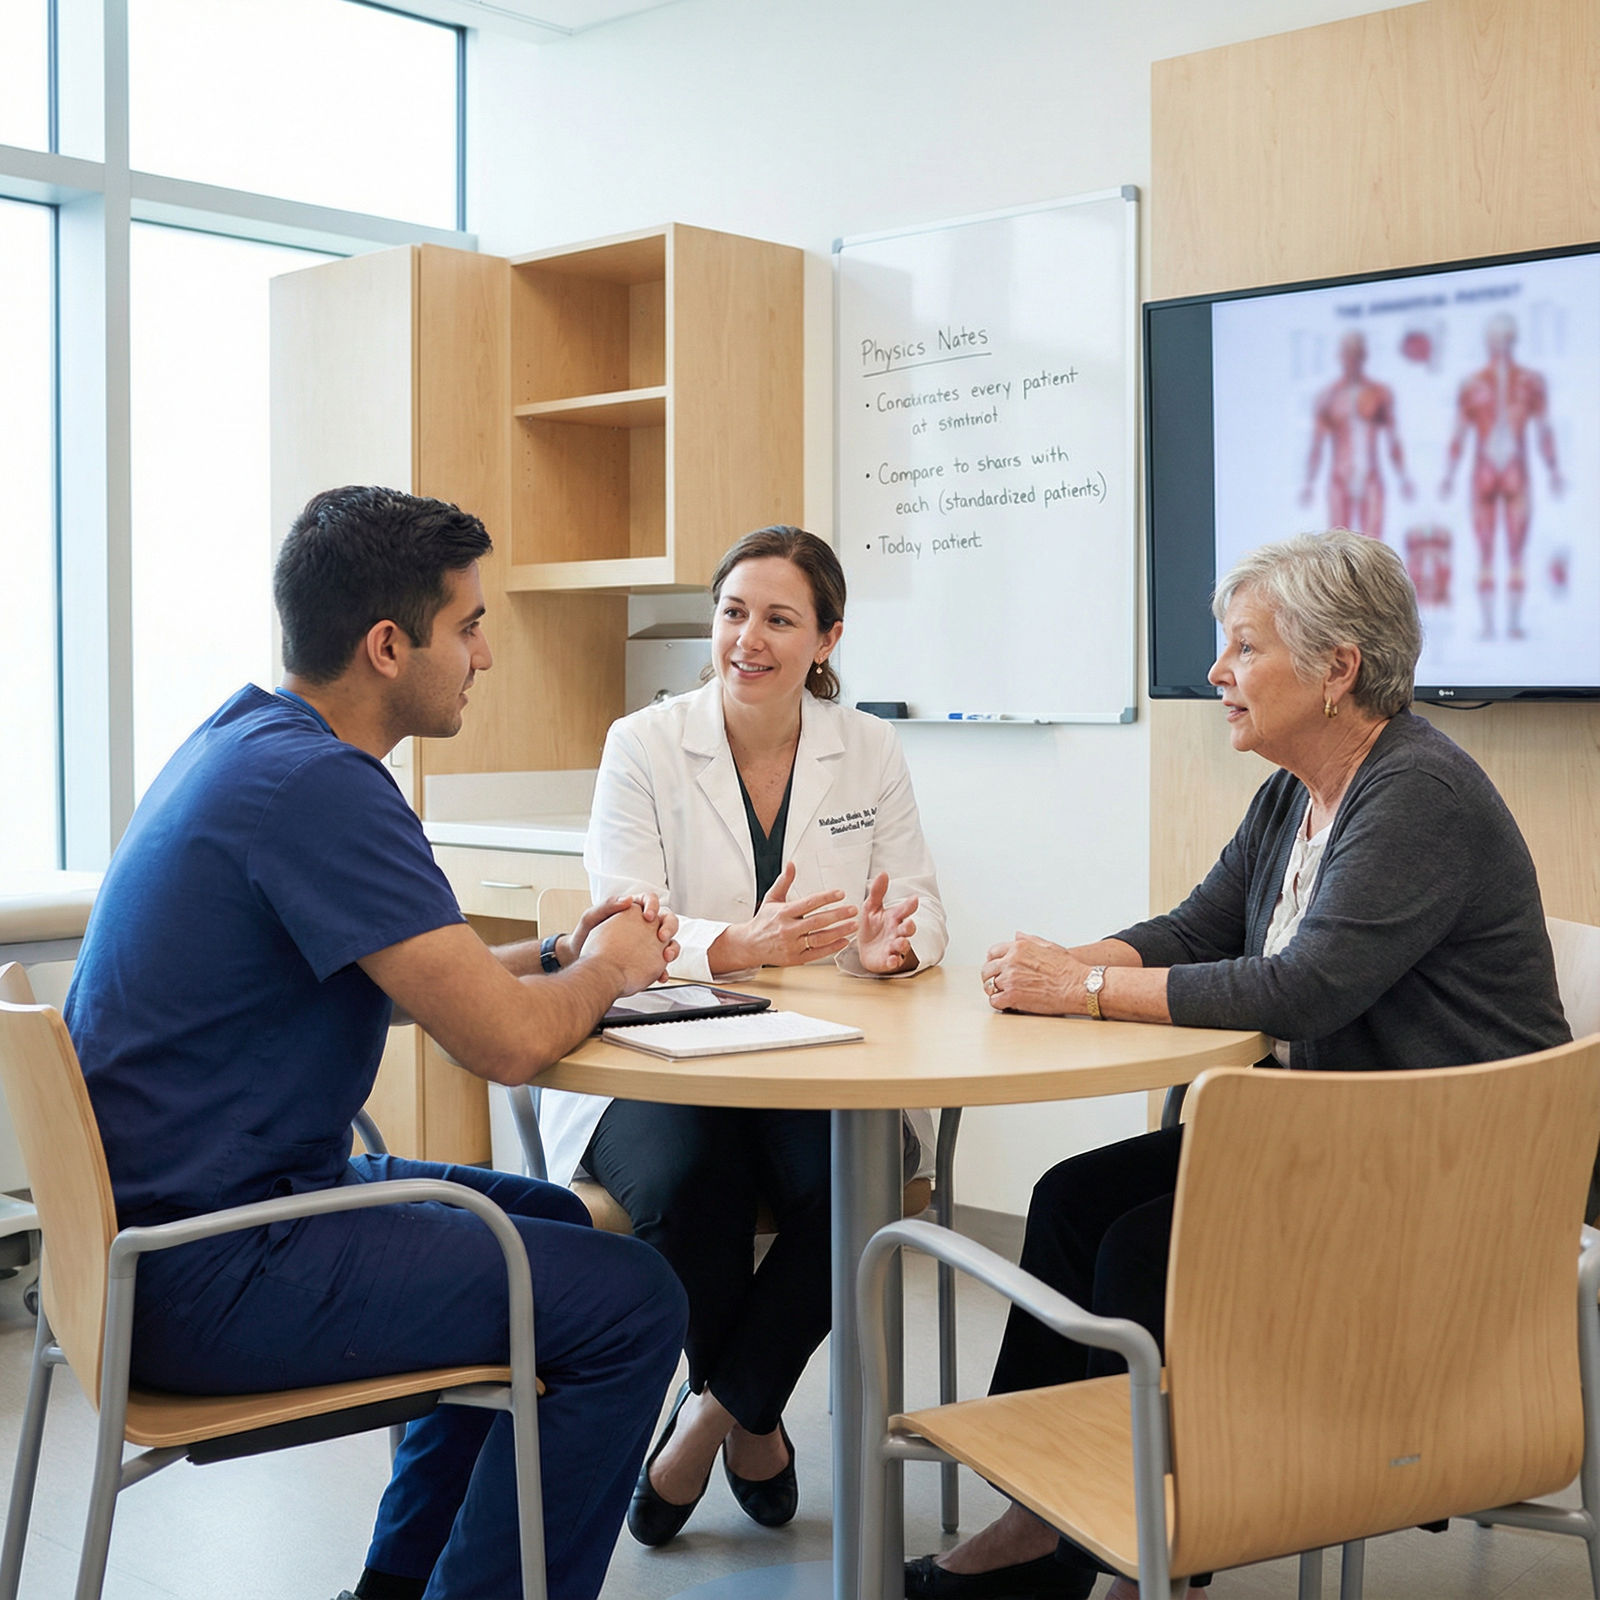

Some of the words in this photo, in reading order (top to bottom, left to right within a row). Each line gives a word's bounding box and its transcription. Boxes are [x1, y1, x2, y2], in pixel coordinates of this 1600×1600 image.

[861, 338, 926, 371] Physics
[971, 381, 1011, 400] every
[1023, 366, 1078, 400] patient
[912, 418, 928, 436] at
[878, 462, 944, 487] Compare
[953, 457, 970, 474] to
[1031, 445, 1069, 465] with
[895, 496, 930, 515] each
[938, 488, 1036, 516] (standardized
[1044, 470, 1108, 509] patients)
[878, 535, 922, 560] Today
